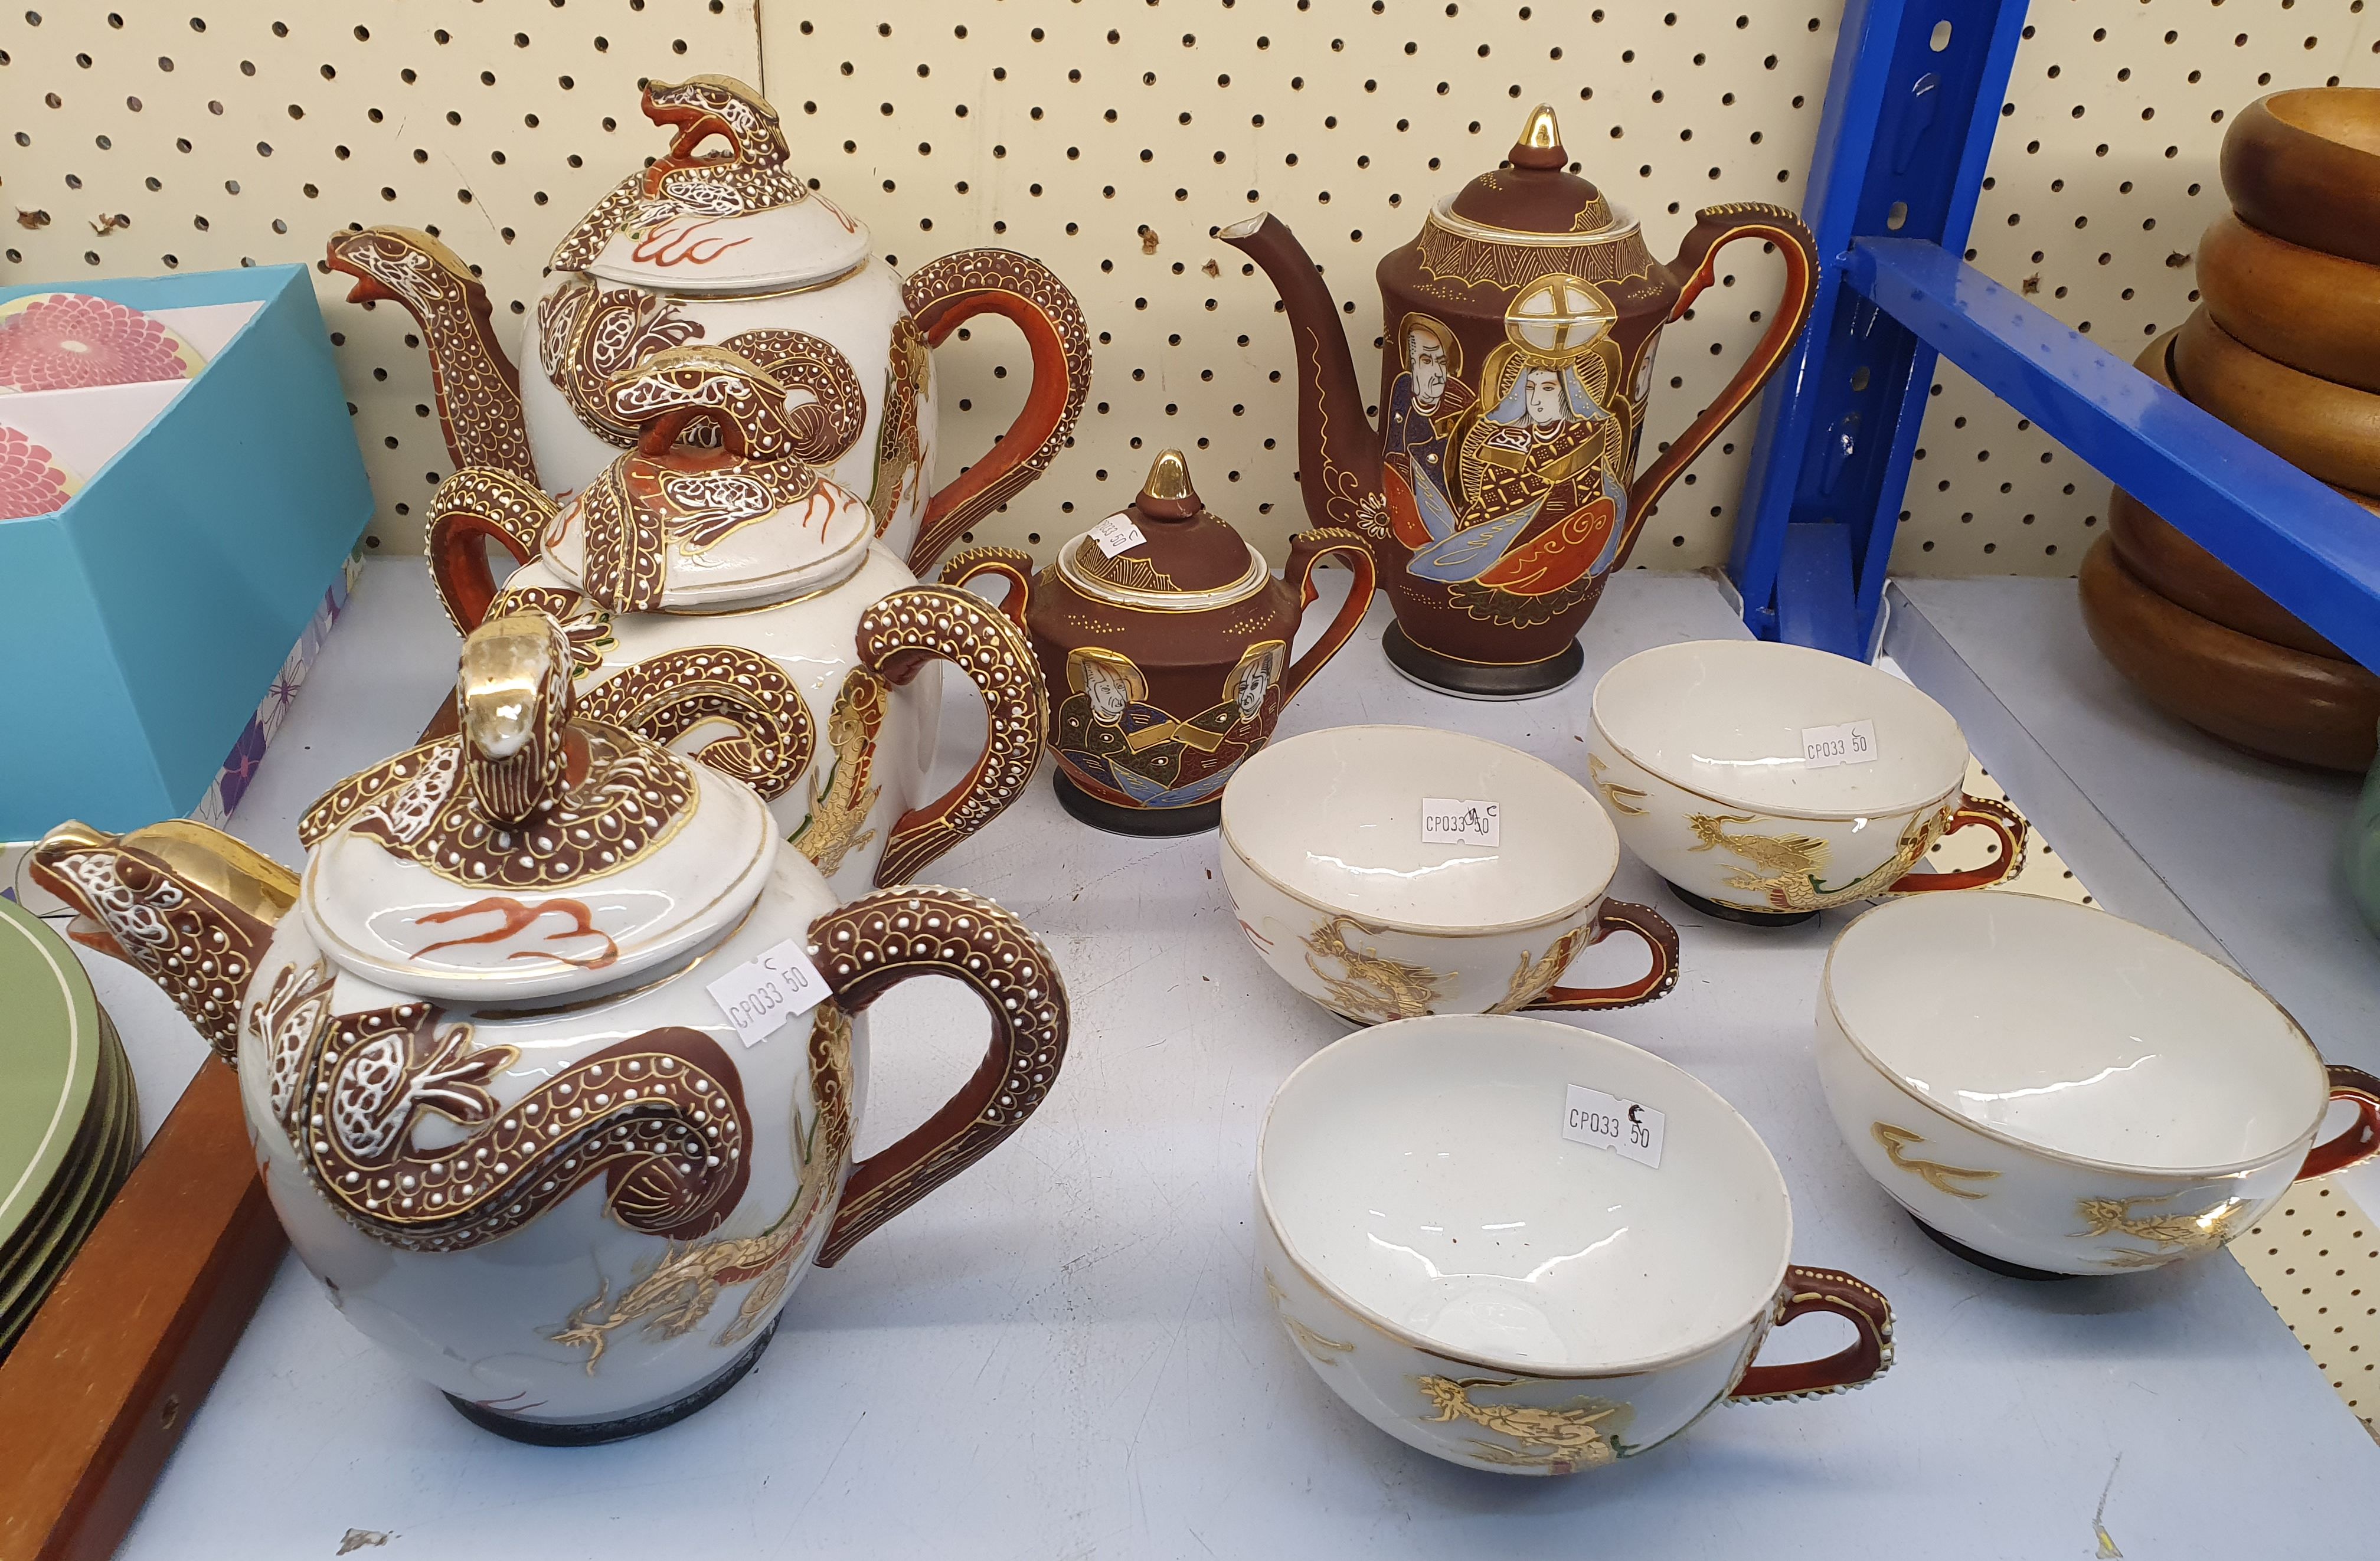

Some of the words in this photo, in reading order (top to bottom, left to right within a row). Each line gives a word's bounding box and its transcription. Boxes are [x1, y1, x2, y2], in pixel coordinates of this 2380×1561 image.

[1110, 534, 1127, 547] 50
[1807, 739, 1845, 760] CP033
[1852, 737, 1868, 752] 50
[1426, 816, 1465, 832] CP033
[1474, 817, 1489, 833] 50
[728, 982, 784, 1029] CP033
[782, 967, 809, 992] 50
[1570, 1108, 1619, 1138] CP033
[1630, 1124, 1650, 1148] 50
